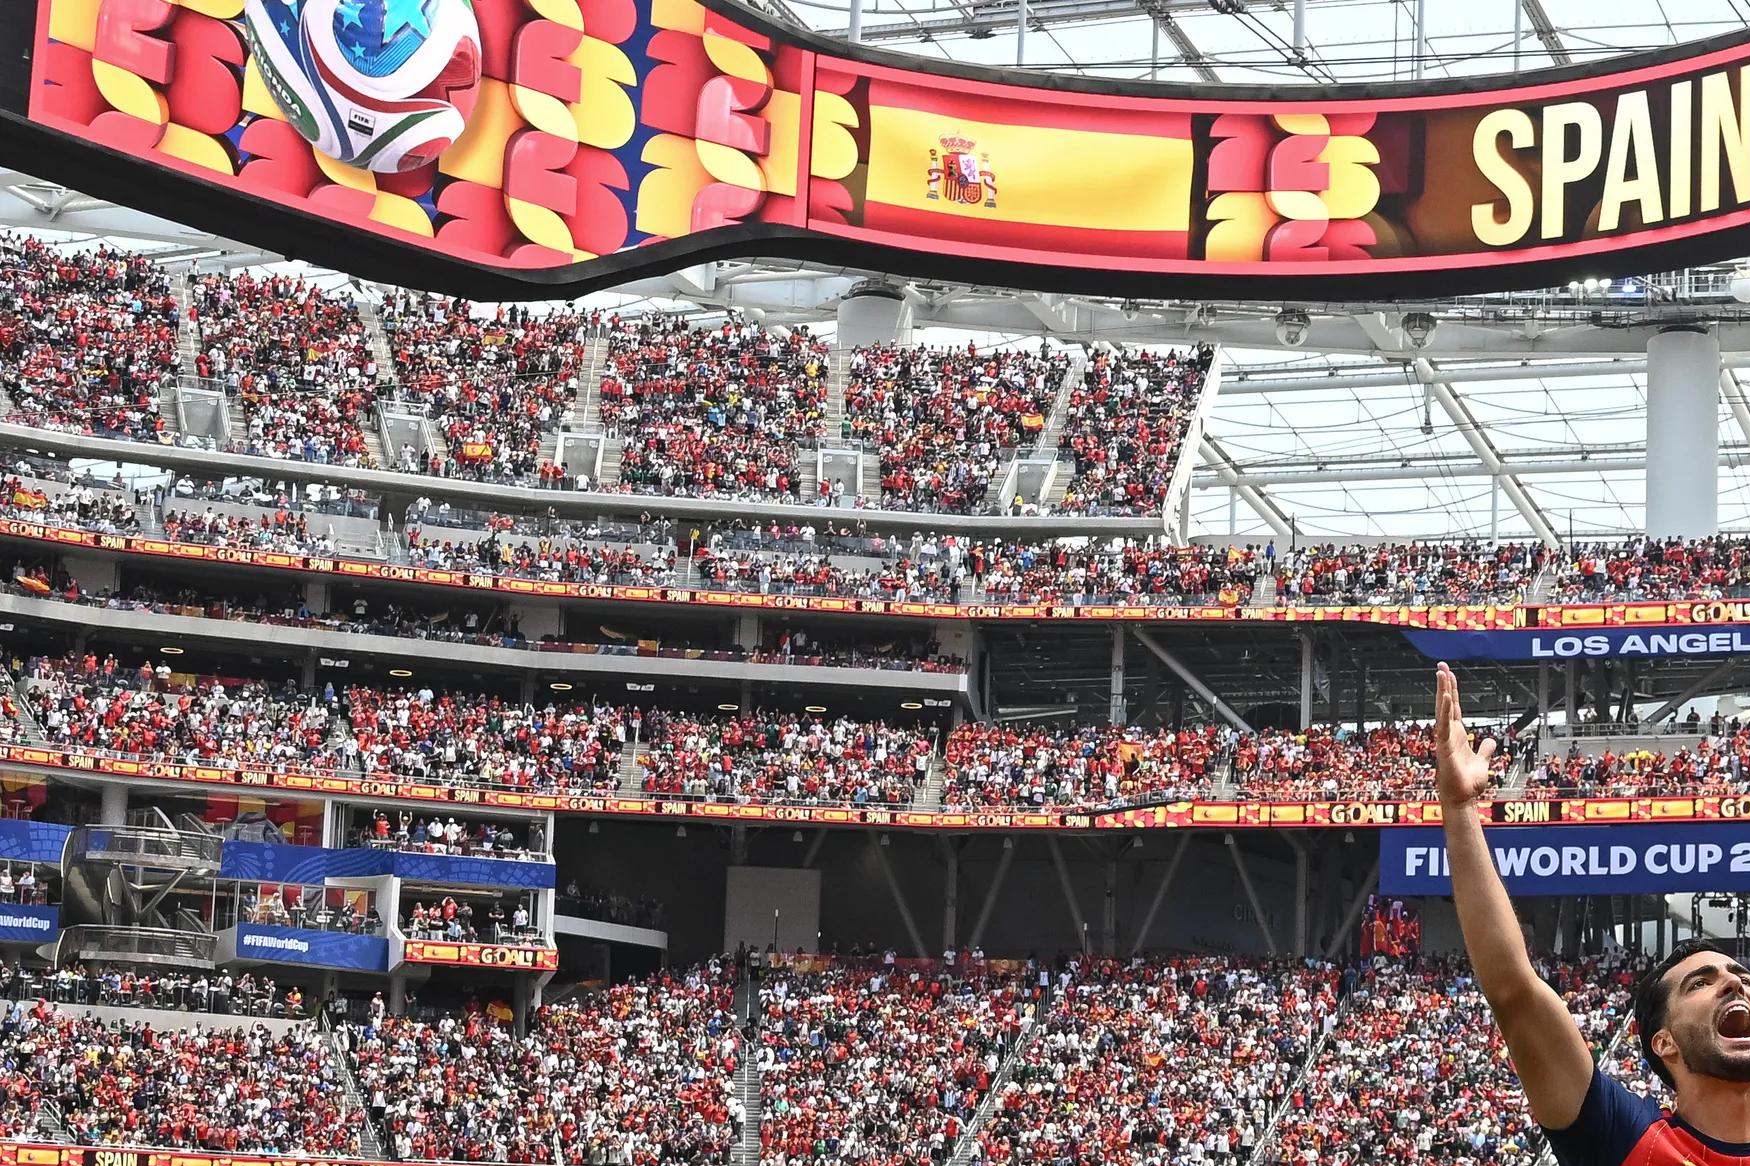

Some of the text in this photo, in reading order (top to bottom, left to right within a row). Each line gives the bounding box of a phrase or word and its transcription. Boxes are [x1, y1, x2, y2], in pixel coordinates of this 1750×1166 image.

[10, 522, 44, 537] GOAL!
[101, 536, 126, 549] SPAIN
[217, 548, 252, 562] GOAL!
[309, 558, 334, 571] SPAIN
[380, 565, 415, 579] GOAL!
[470, 575, 494, 588] SPAIN
[579, 584, 612, 597] GOAL!
[667, 590, 691, 602] SPAIN
[775, 595, 808, 608] GOAL!
[861, 600, 885, 612] SPAIN
[968, 606, 1000, 618] GOAL!
[1052, 606, 1075, 618] SPAIN
[1157, 607, 1190, 618] GOAL!
[1241, 608, 1264, 620] SPAIN
[1532, 635, 1610, 657] LOS
[69, 755, 94, 769] SPAIN
[241, 771, 267, 785] SPAIN
[361, 781, 396, 795] GOAL!
[454, 788, 479, 802] SPAIN
[569, 797, 604, 810] GOAL!
[661, 801, 686, 814] SPAIN
[775, 807, 809, 820] GOAL!
[866, 811, 890, 823] SPAIN
[1331, 802, 1394, 824] GOAL!
[1504, 801, 1549, 822] SPAIN
[977, 815, 1010, 827] GOAL!
[1066, 815, 1089, 827] SPAIN
[1406, 847, 1450, 877] FI
[1496, 845, 1637, 877] WORLD
[1645, 843, 1722, 874] CUP
[243, 935, 309, 952] #FIFAWorldCup
[481, 947, 534, 967] GOAL!
